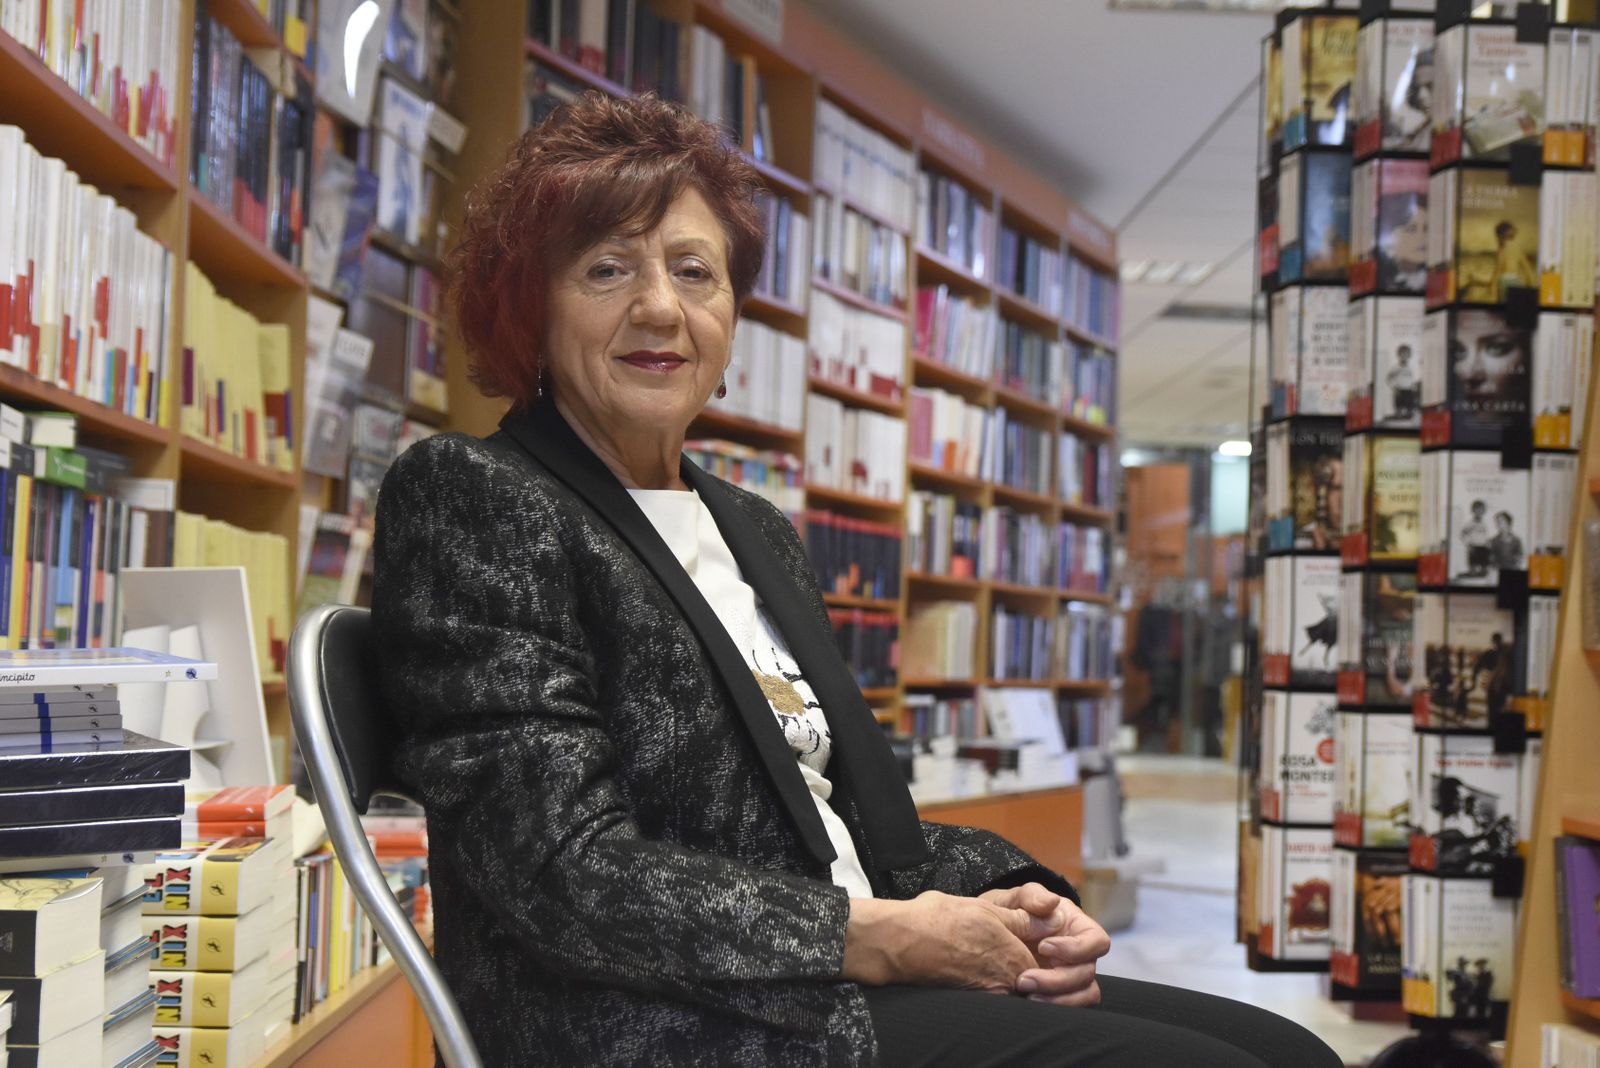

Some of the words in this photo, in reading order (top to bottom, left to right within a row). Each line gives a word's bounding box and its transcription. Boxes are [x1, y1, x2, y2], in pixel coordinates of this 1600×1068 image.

[164, 867, 191, 911] NIX
[161, 923, 188, 967] NIX
[156, 979, 183, 1022] NIX
